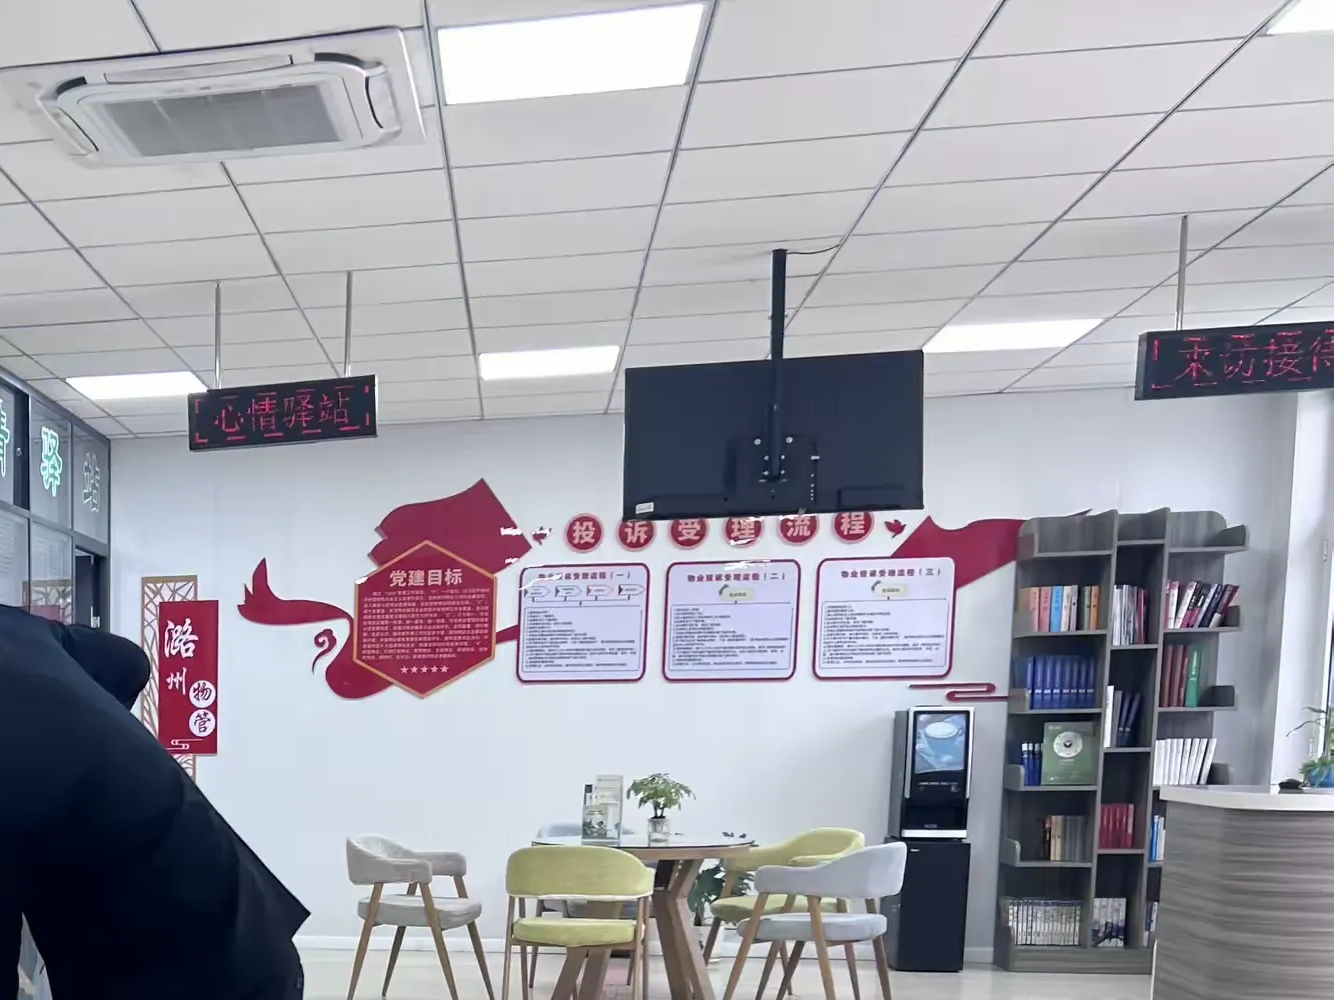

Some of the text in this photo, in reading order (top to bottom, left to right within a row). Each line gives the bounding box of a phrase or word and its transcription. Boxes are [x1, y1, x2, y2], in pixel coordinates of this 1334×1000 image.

[213, 390, 351, 434] 心情驿站
[571, 511, 866, 545] 投诉受理流程
[389, 567, 463, 587] 党建目标
[164, 617, 199, 696] 潞州
